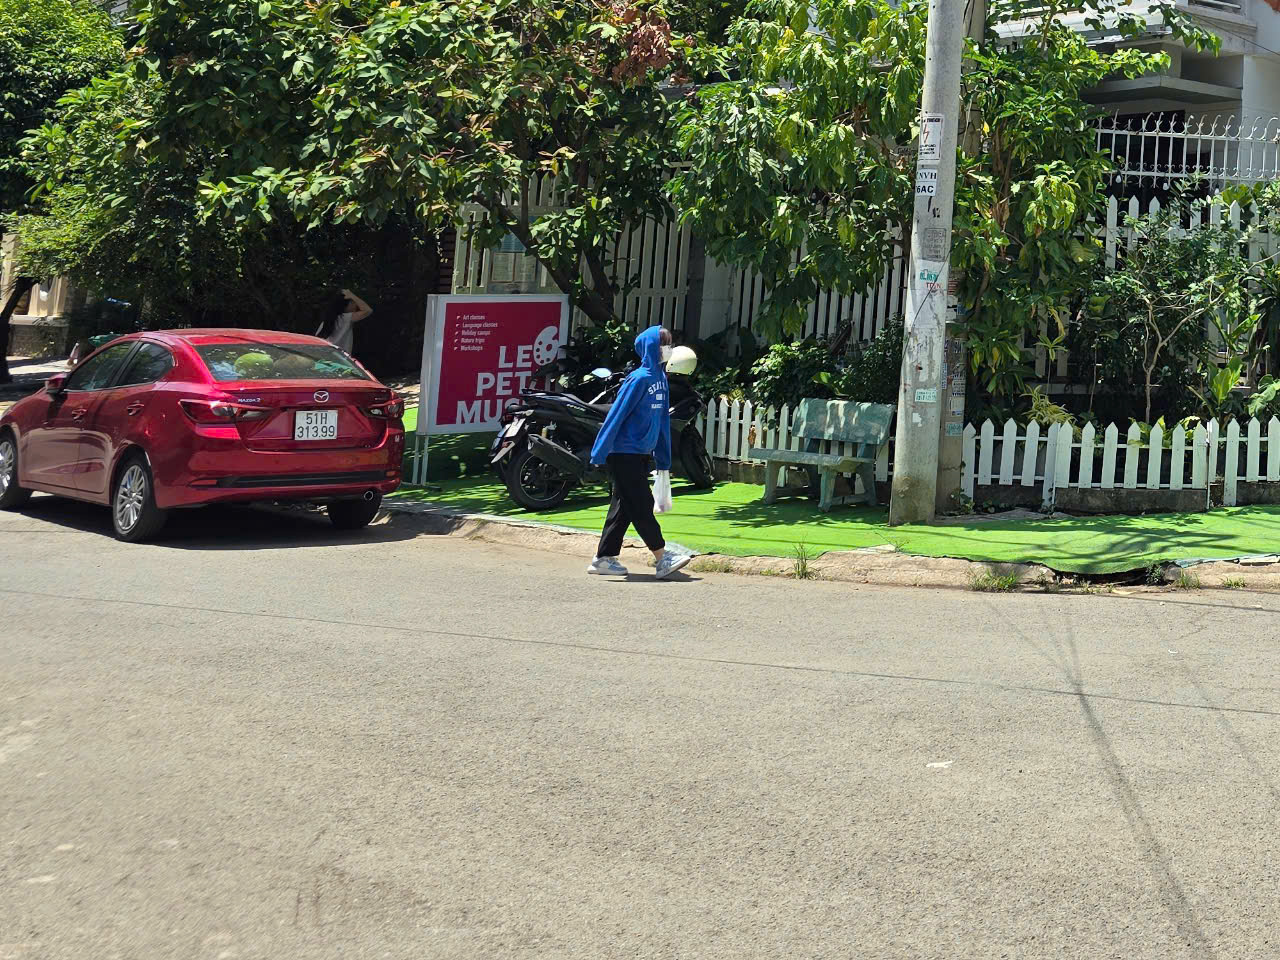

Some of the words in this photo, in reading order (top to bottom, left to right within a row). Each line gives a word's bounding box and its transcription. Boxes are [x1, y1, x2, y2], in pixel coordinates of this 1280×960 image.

[499, 345, 533, 368] LE
[306, 413, 328, 425] 51H
[297, 426, 335, 439] 313.99
